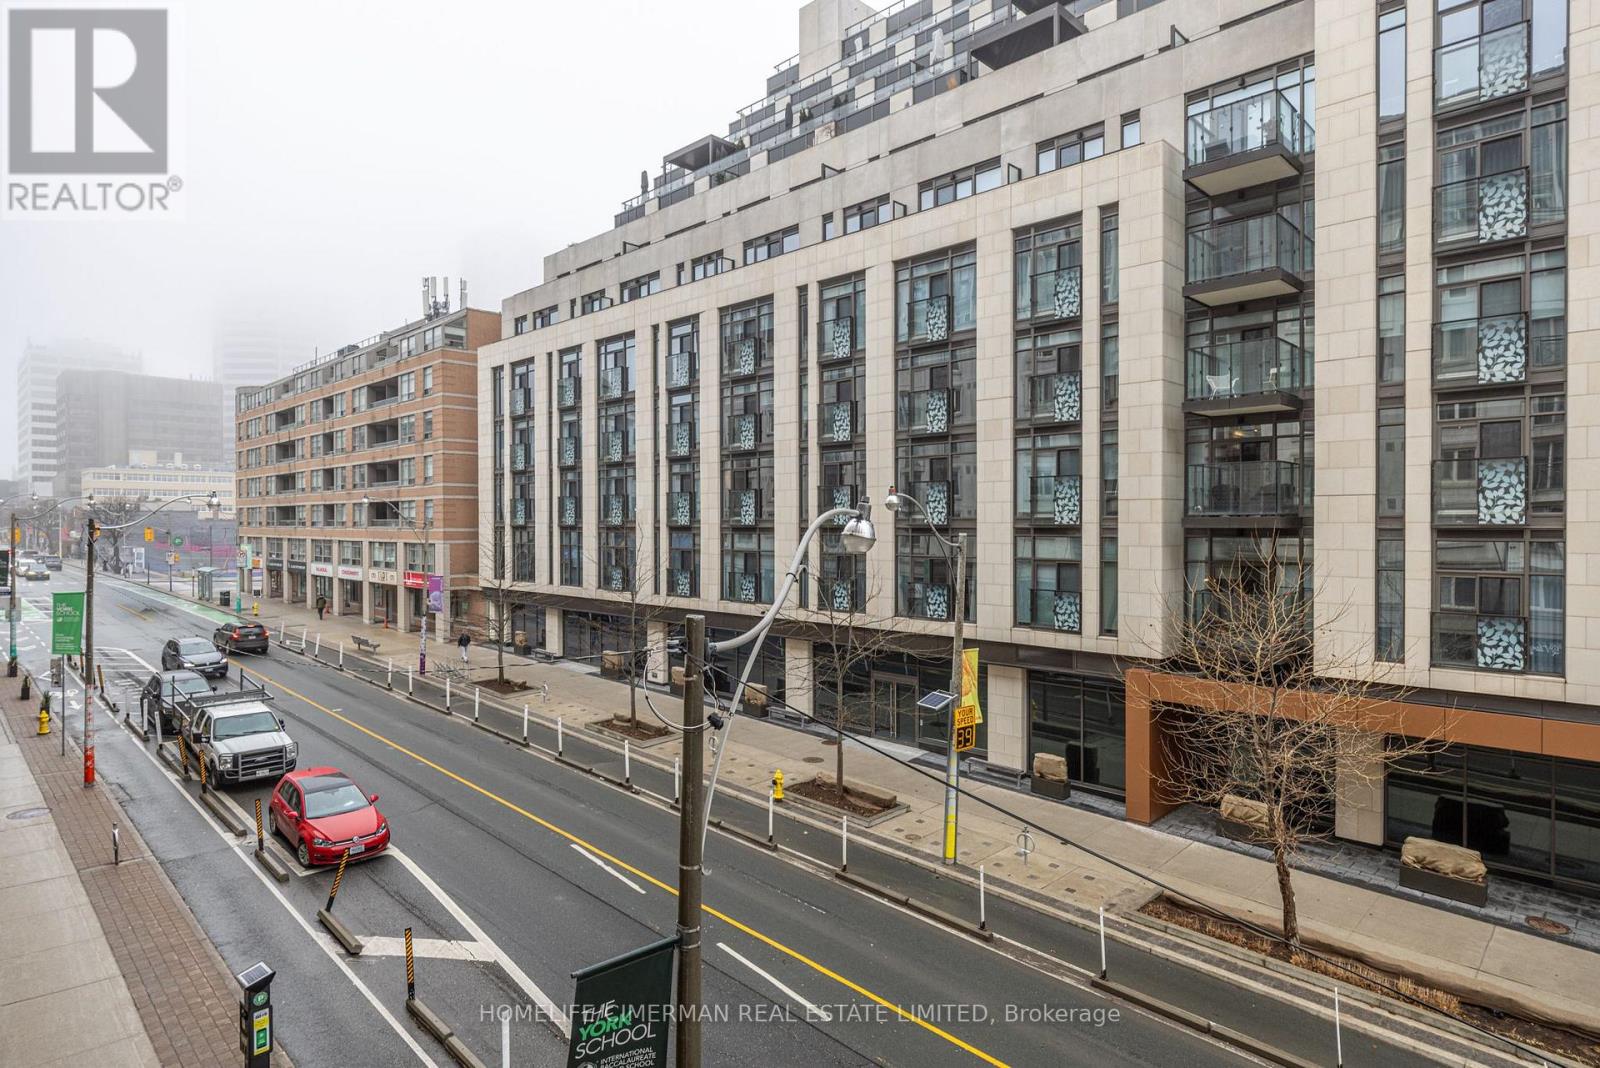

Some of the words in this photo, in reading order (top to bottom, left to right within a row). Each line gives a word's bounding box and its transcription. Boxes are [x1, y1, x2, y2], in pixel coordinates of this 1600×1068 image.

[957, 708, 973, 718] YOUR
[957, 716, 973, 726] SPEED
[958, 728, 972, 748] 39
[581, 999, 616, 1024] THE
[579, 1008, 632, 1041] YORK
[574, 1022, 657, 1060] SCHOOL
[600, 1047, 653, 1064] INTERNATIONAL
